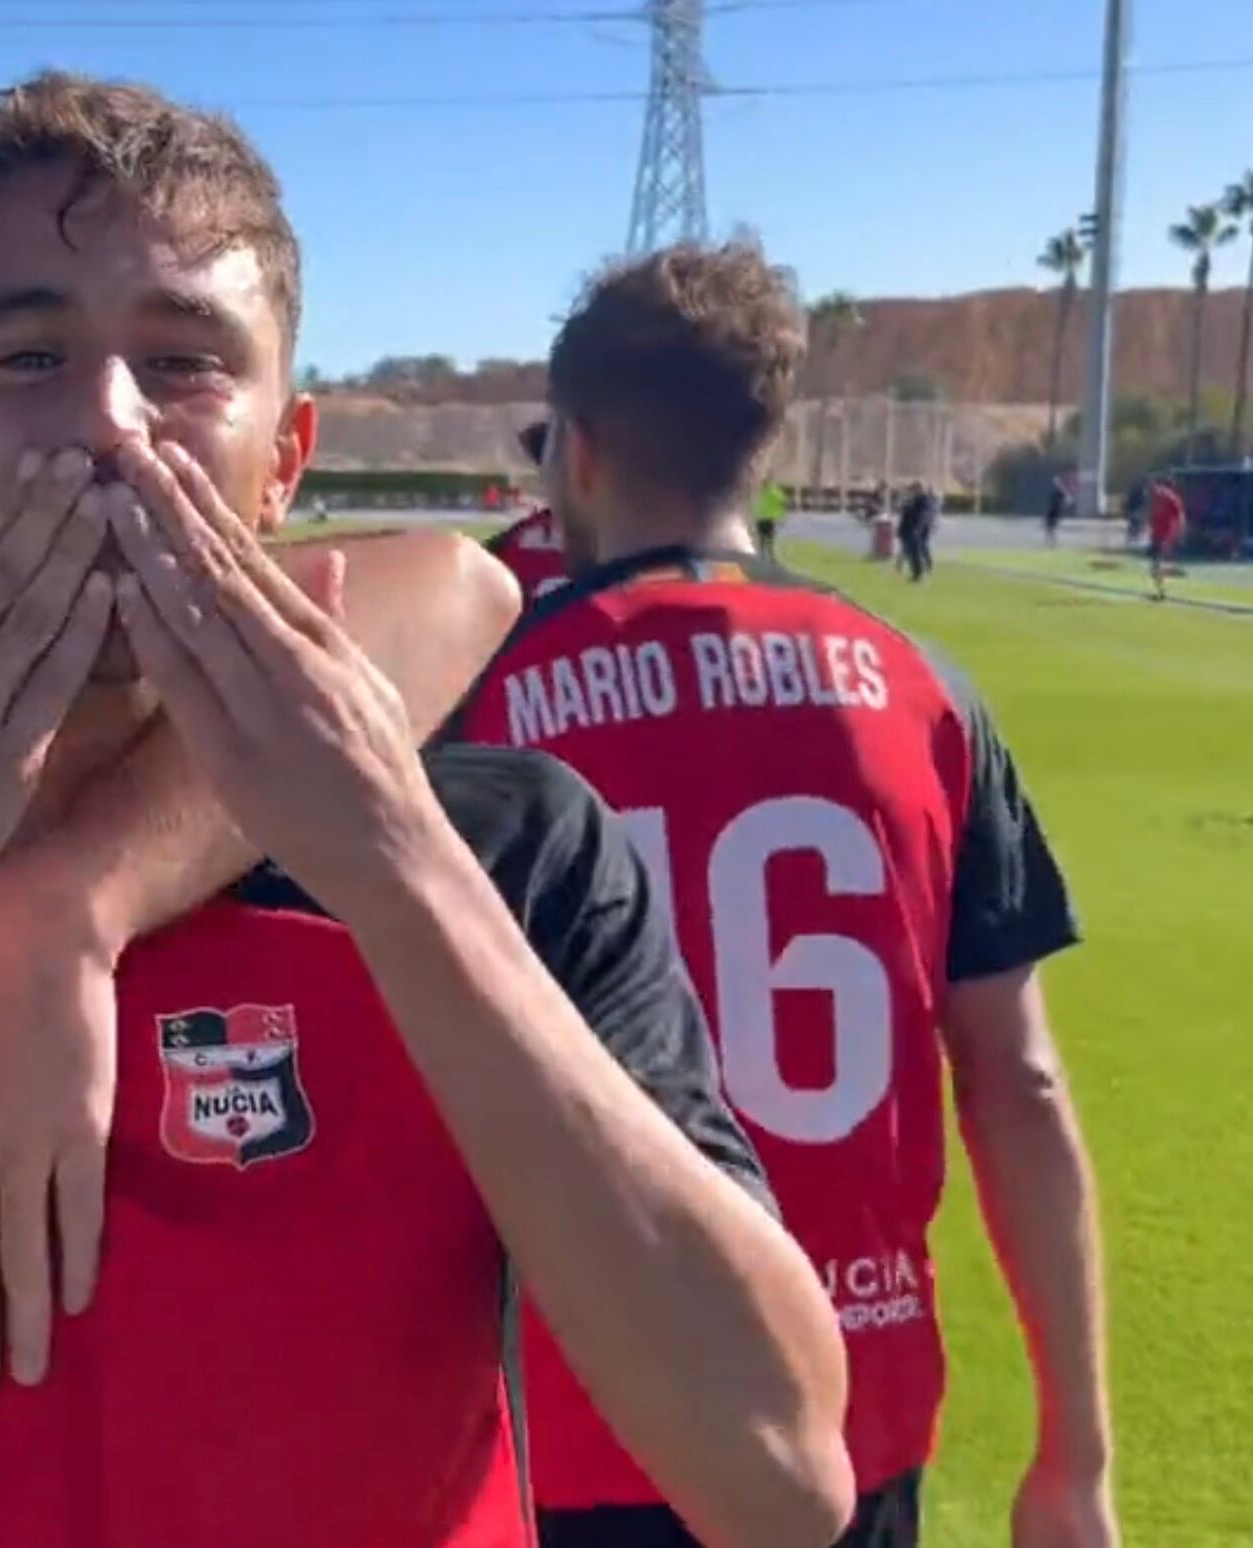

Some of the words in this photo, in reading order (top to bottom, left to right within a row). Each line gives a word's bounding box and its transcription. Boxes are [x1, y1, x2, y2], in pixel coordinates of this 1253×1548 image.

[503, 640, 677, 748] MARIO
[690, 631, 888, 710] ROBLES
[194, 1091, 278, 1121] NUCIA
